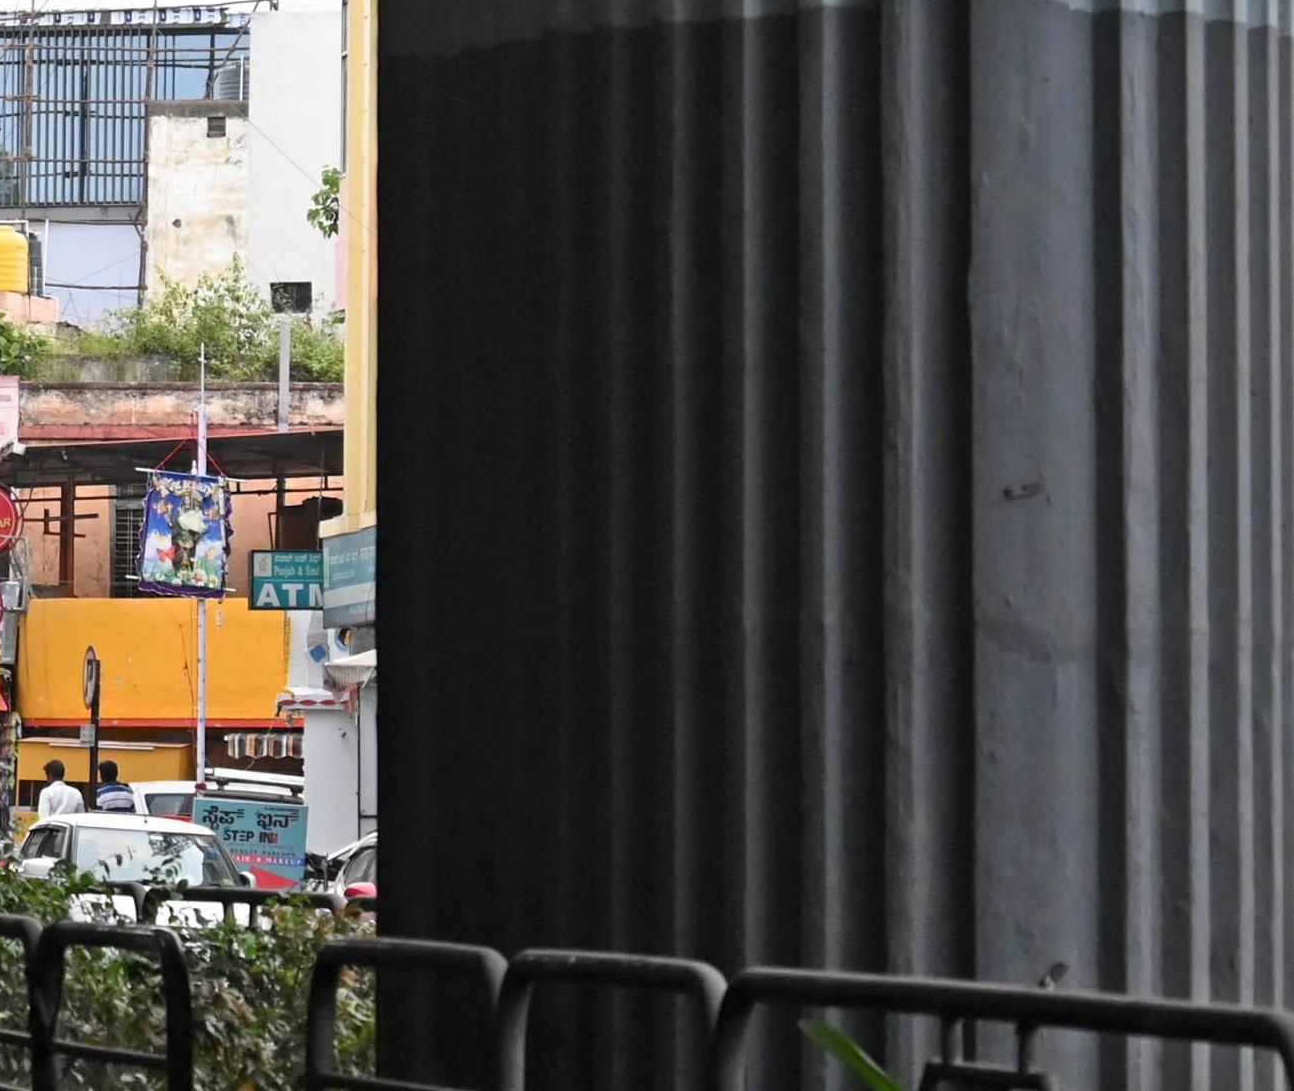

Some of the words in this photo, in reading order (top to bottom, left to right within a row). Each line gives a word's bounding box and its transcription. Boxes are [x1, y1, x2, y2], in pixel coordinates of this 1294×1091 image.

[274, 566, 295, 578] Punjab
[256, 583, 323, 607] ATM
[223, 830, 255, 843] STEP
[232, 855, 250, 863] AIR
[264, 856, 302, 865] MAKEUP
